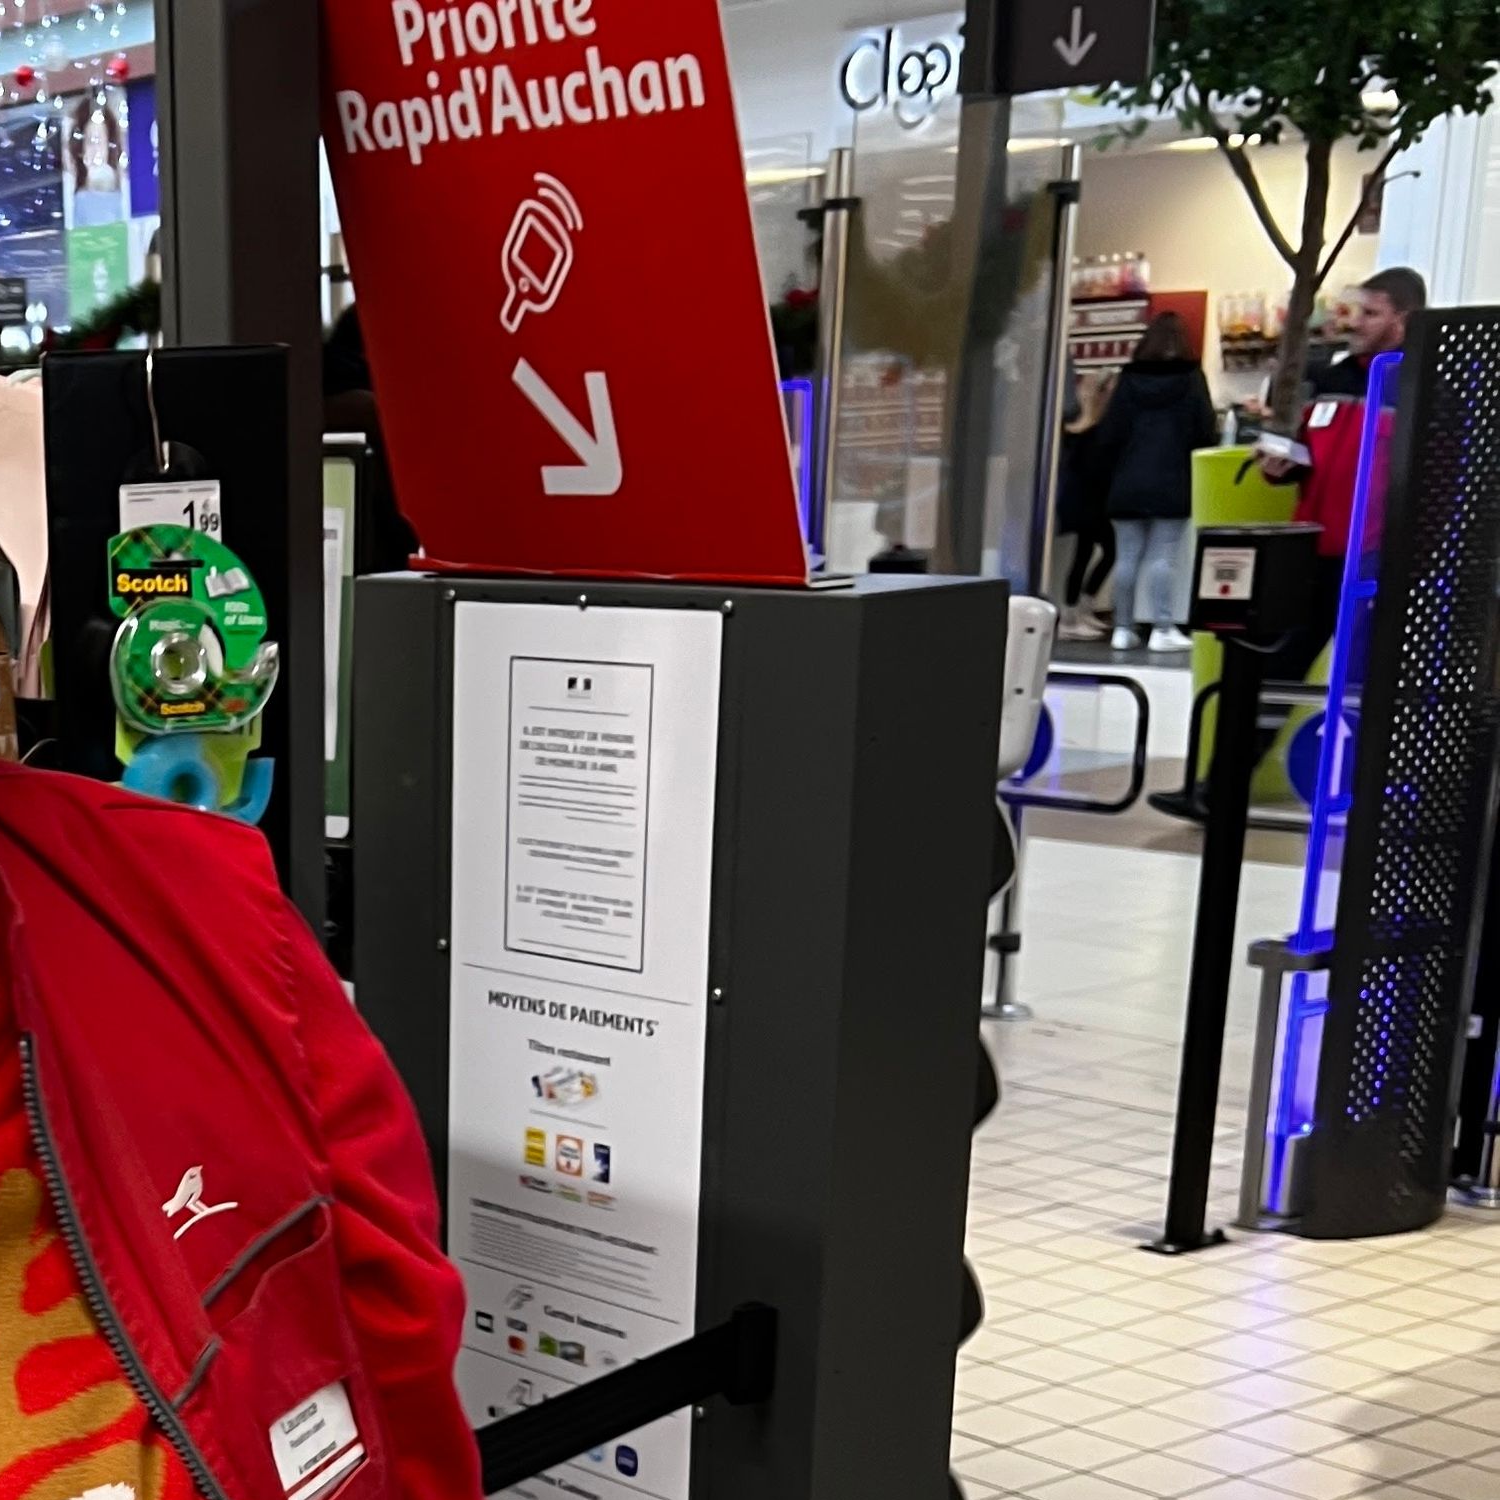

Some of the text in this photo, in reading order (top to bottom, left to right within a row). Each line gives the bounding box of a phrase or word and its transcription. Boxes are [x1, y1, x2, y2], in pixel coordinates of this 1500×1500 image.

[335, 46, 705, 166] Rapid'Auchan
[116, 573, 188, 594] Scotch
[488, 990, 546, 1015] MOYENS
[549, 1001, 567, 1020] DE
